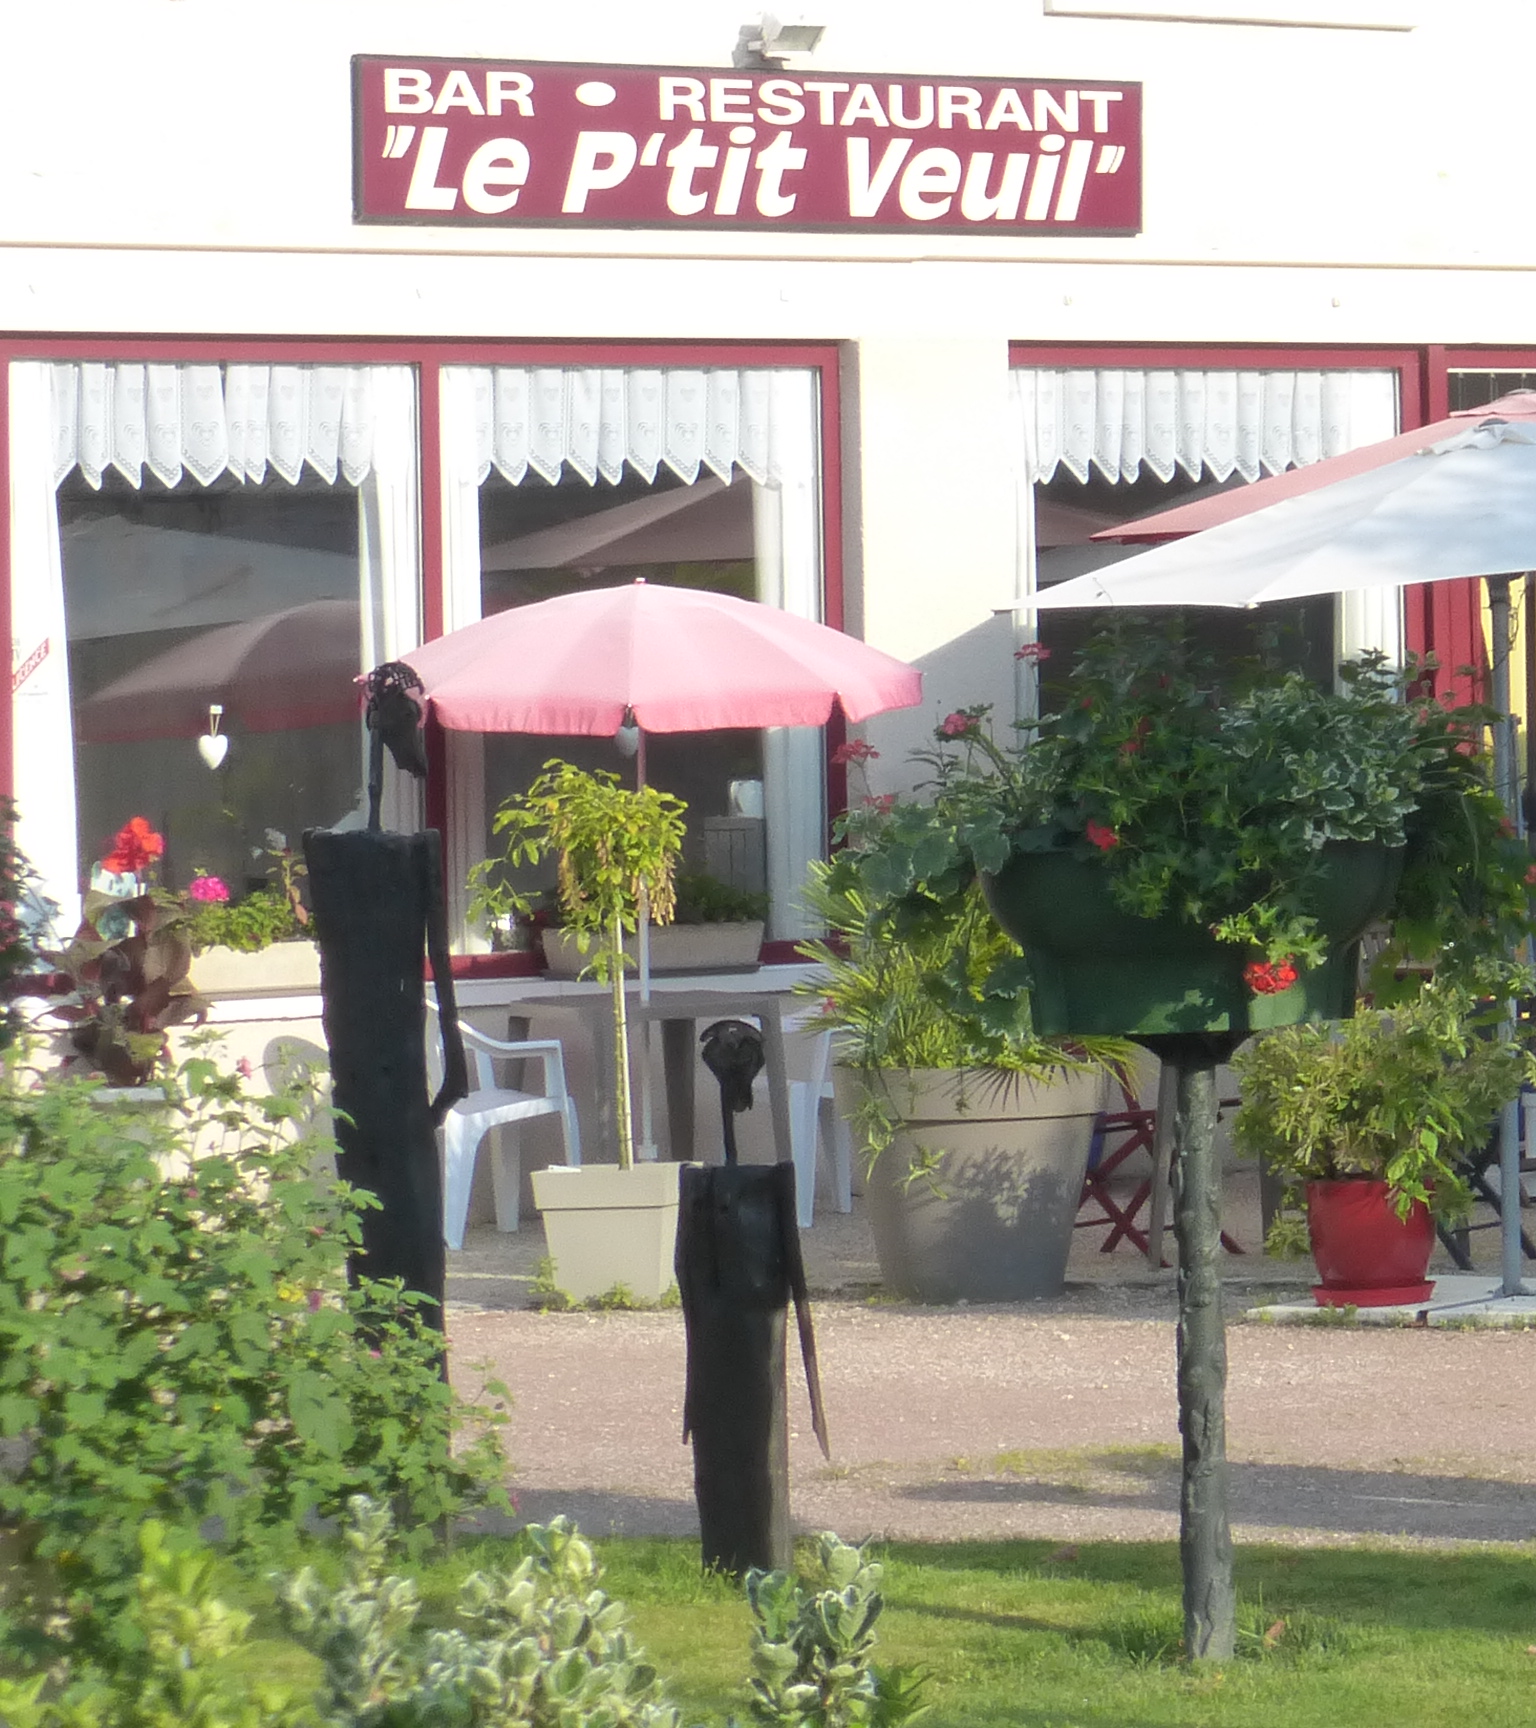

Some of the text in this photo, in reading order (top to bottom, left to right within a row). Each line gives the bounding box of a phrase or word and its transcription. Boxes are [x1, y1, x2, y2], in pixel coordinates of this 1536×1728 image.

[383, 67, 1123, 134] BAR RESTAURANT
[560, 125, 808, 217] P'tit
